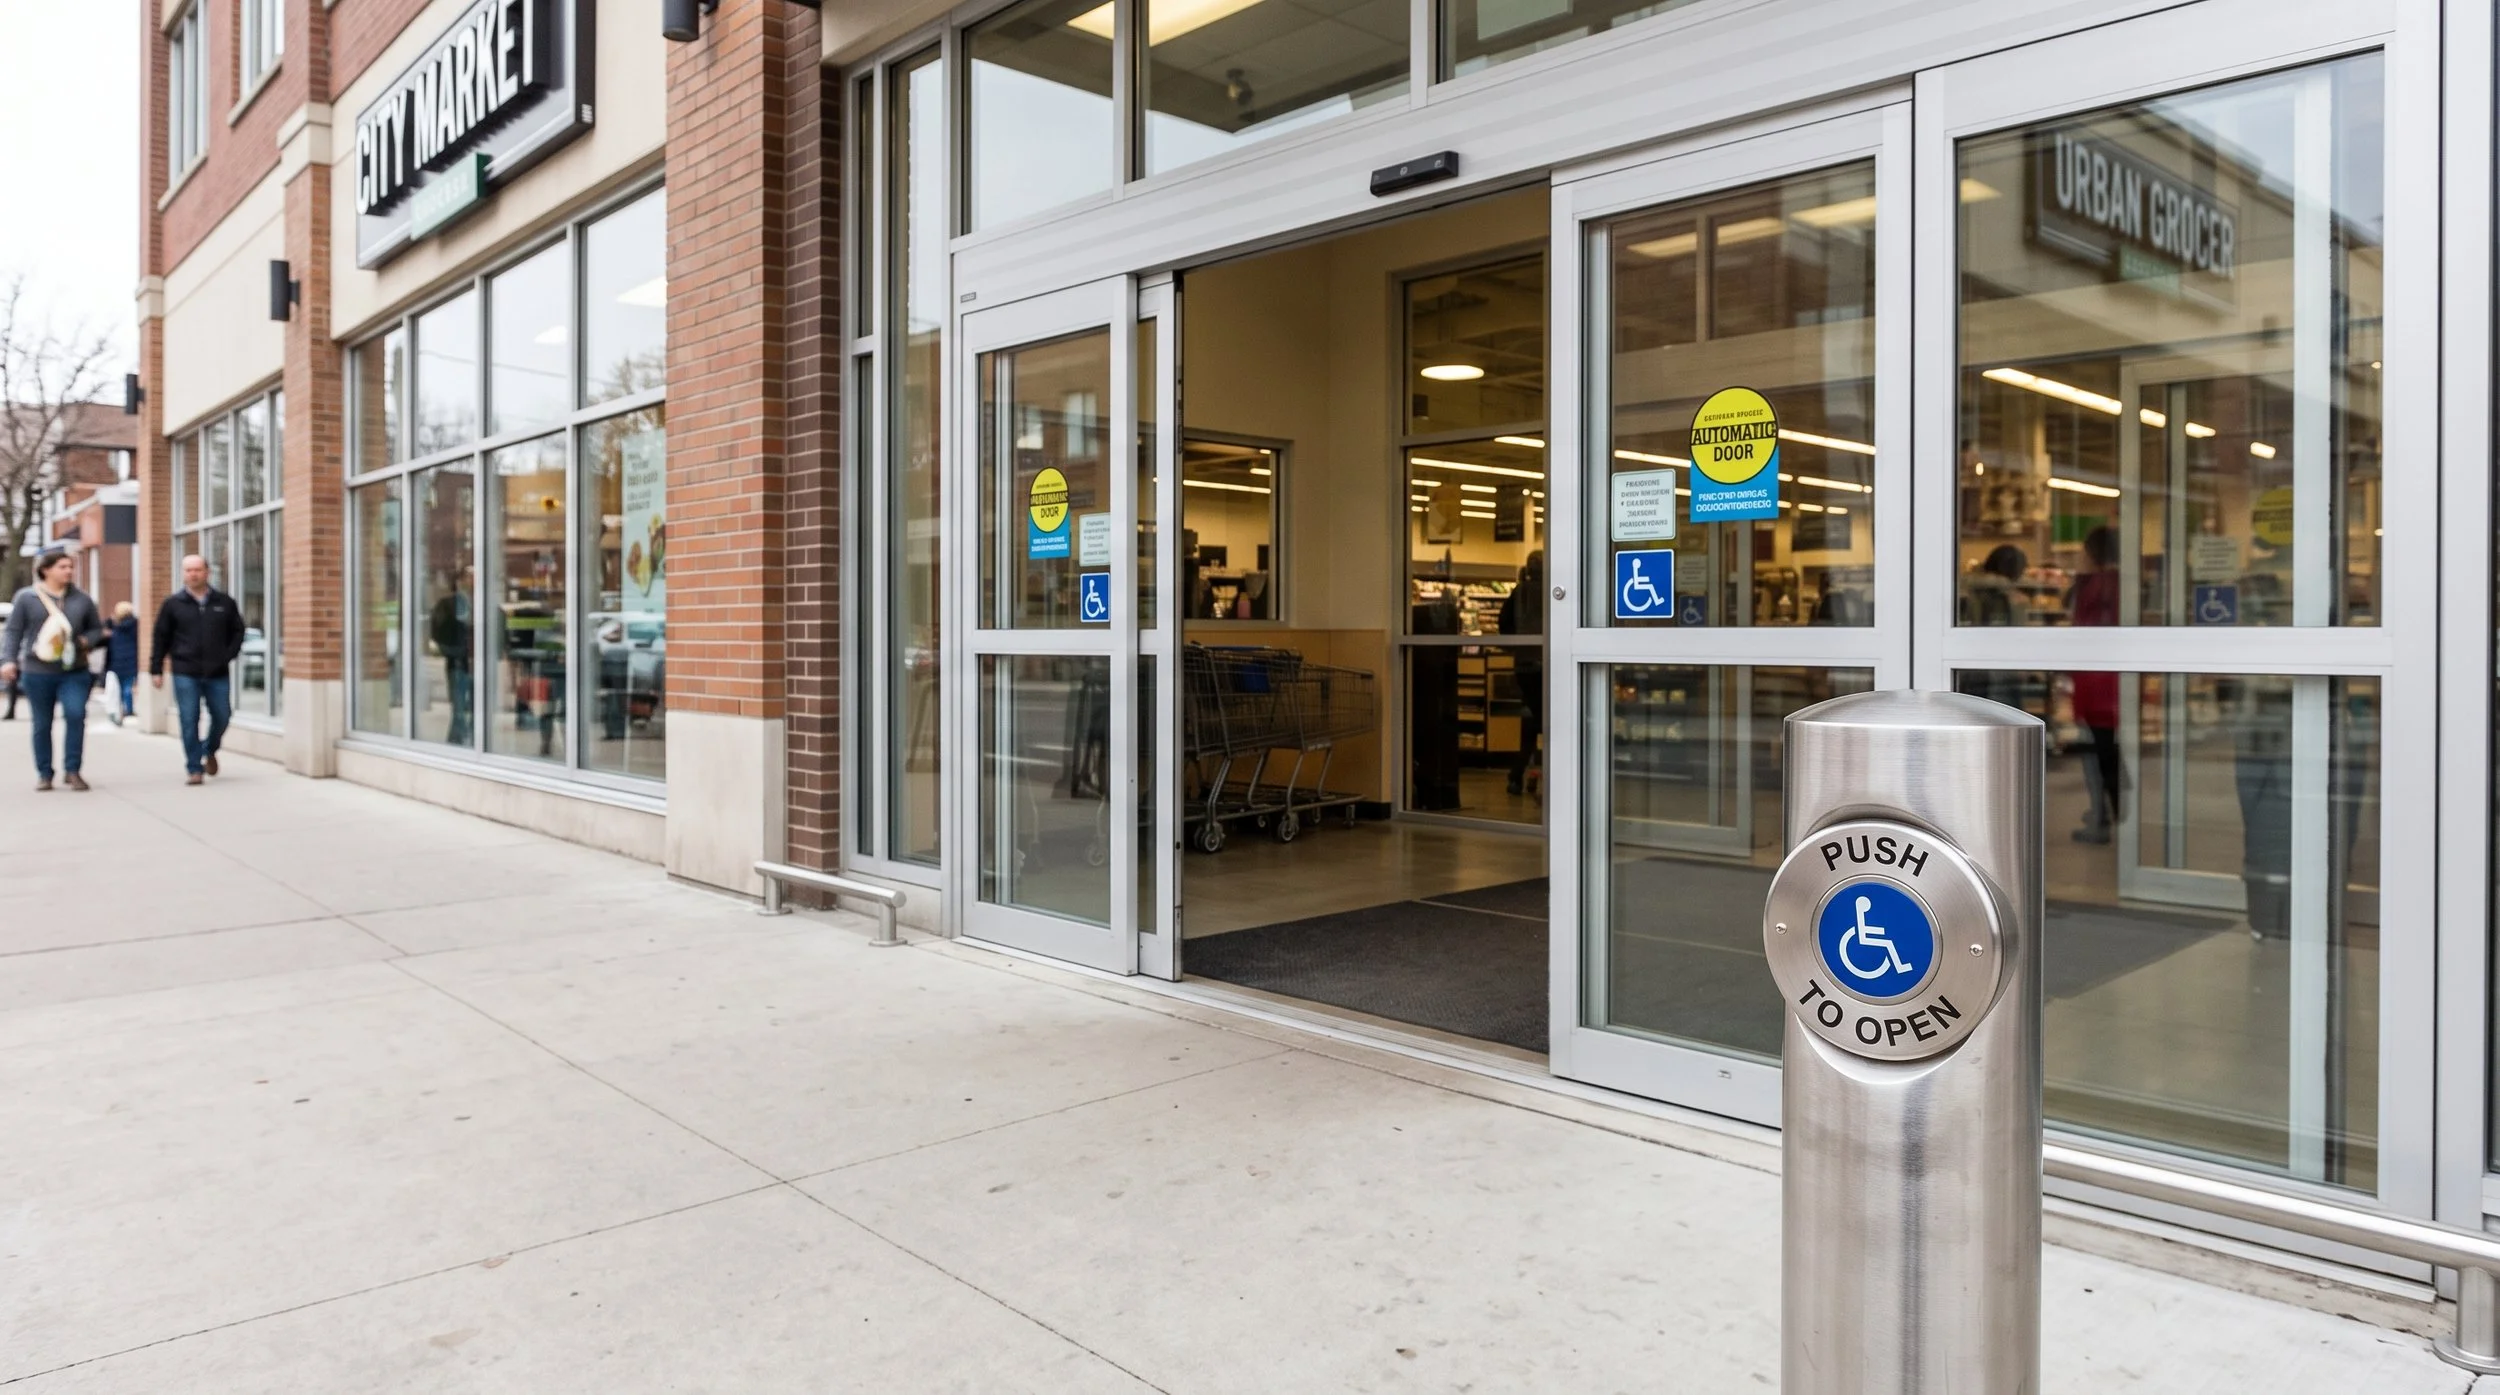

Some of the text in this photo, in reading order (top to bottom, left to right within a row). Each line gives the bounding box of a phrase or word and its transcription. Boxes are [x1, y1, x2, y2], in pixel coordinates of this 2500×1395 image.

[355, 88, 407, 215] CITY
[2055, 132, 2142, 241] URBAN
[2150, 180, 2235, 280] GROCER
[1692, 421, 1775, 445] AUTOMATIC
[1713, 443, 1754, 462] DOOR
[1820, 835, 1929, 877] PUSH
[1798, 979, 1962, 1046] TO OPEN
